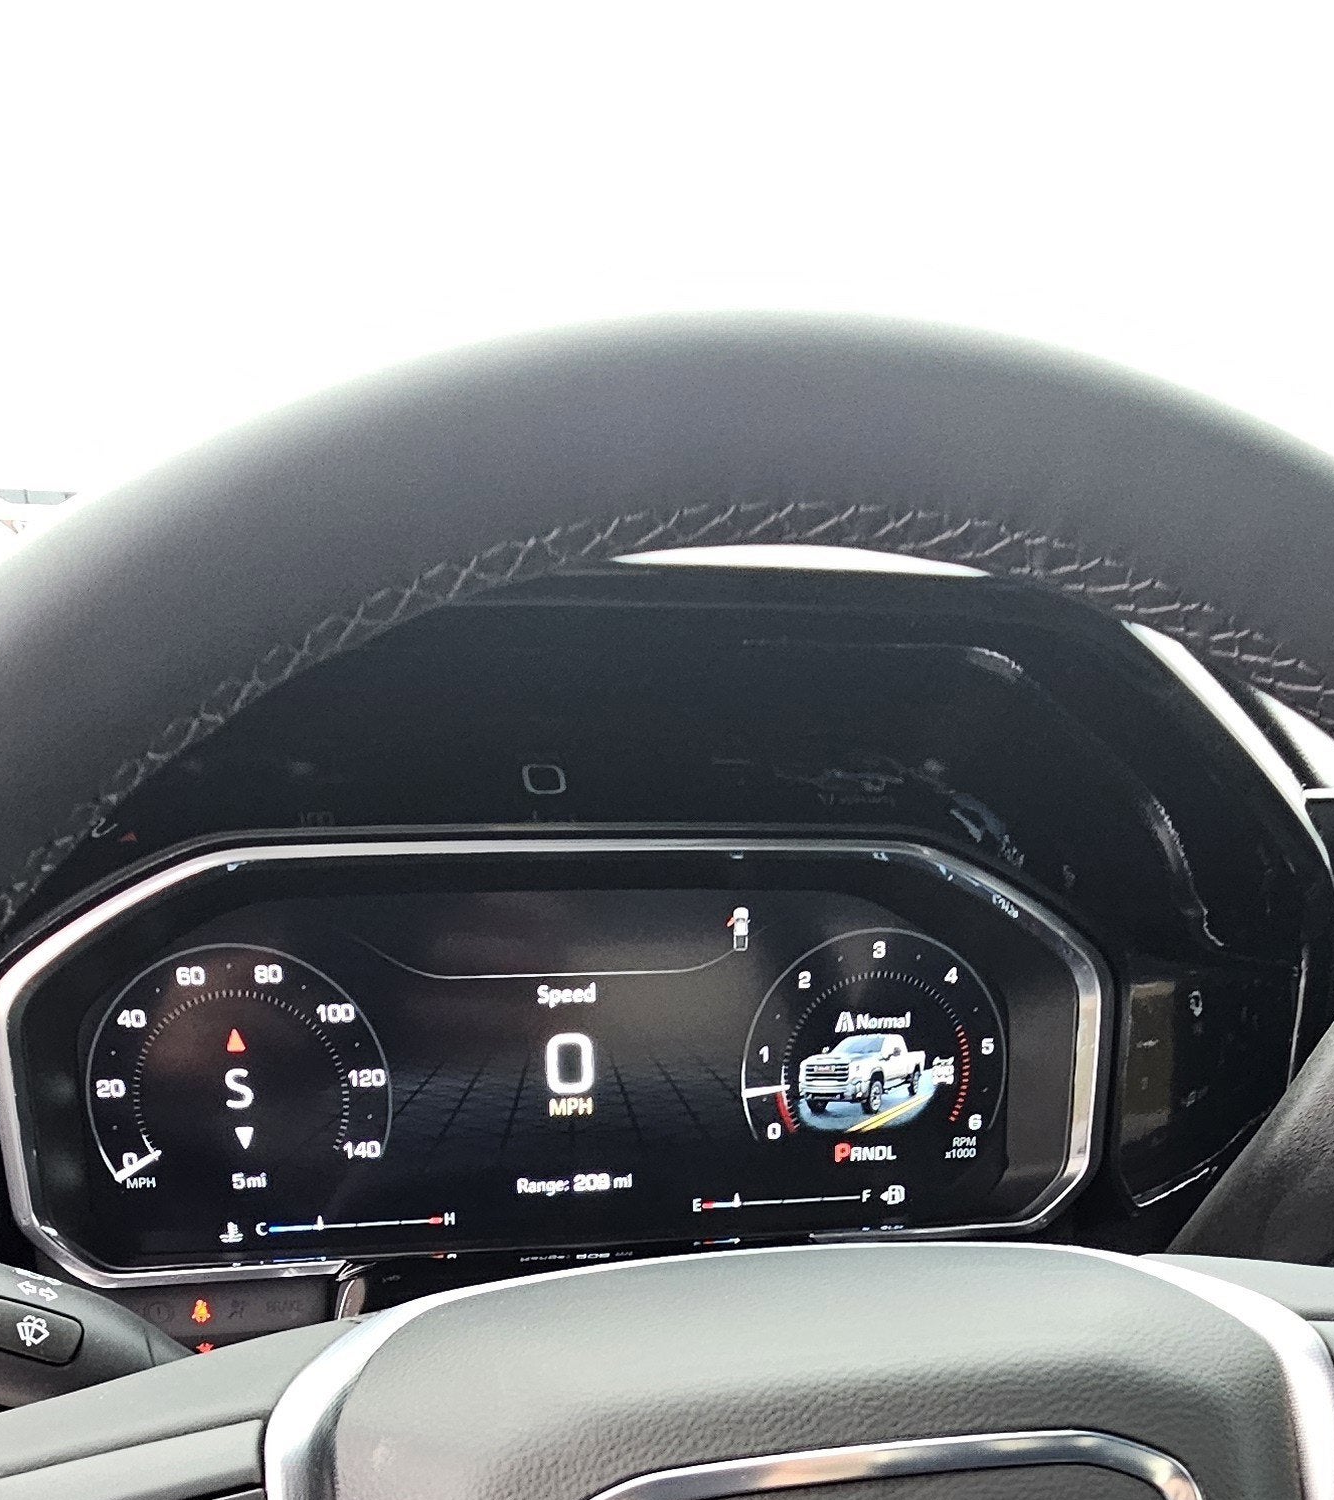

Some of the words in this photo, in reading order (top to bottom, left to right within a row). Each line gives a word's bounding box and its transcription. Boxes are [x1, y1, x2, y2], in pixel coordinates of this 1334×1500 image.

[872, 940, 887, 959] 3
[175, 965, 207, 986] 60
[253, 963, 284, 985] 80
[798, 970, 812, 989] 2
[944, 966, 959, 984] 4
[536, 981, 597, 1009] Speed
[116, 1008, 148, 1029] 40
[316, 1002, 358, 1024] 100
[856, 1012, 911, 1031] Normal
[758, 1045, 769, 1064] 1
[981, 1037, 995, 1056] 5
[544, 1032, 595, 1096] 0
[348, 1068, 387, 1088] 120
[95, 1078, 127, 1099] 20
[224, 1067, 255, 1110] S
[548, 1097, 594, 1117] MPH
[767, 1122, 782, 1140] 0
[968, 1113, 983, 1131] 6
[343, 1140, 382, 1160] 140
[952, 1135, 977, 1148] RPM
[944, 1147, 977, 1159] x1000
[125, 1176, 157, 1190] MPH
[516, 1177, 570, 1197] Range:
[612, 1173, 633, 1189] mi
[692, 1197, 702, 1213] E
[860, 1188, 872, 1203] F
[442, 1211, 456, 1227] H
[255, 1221, 268, 1237] C
